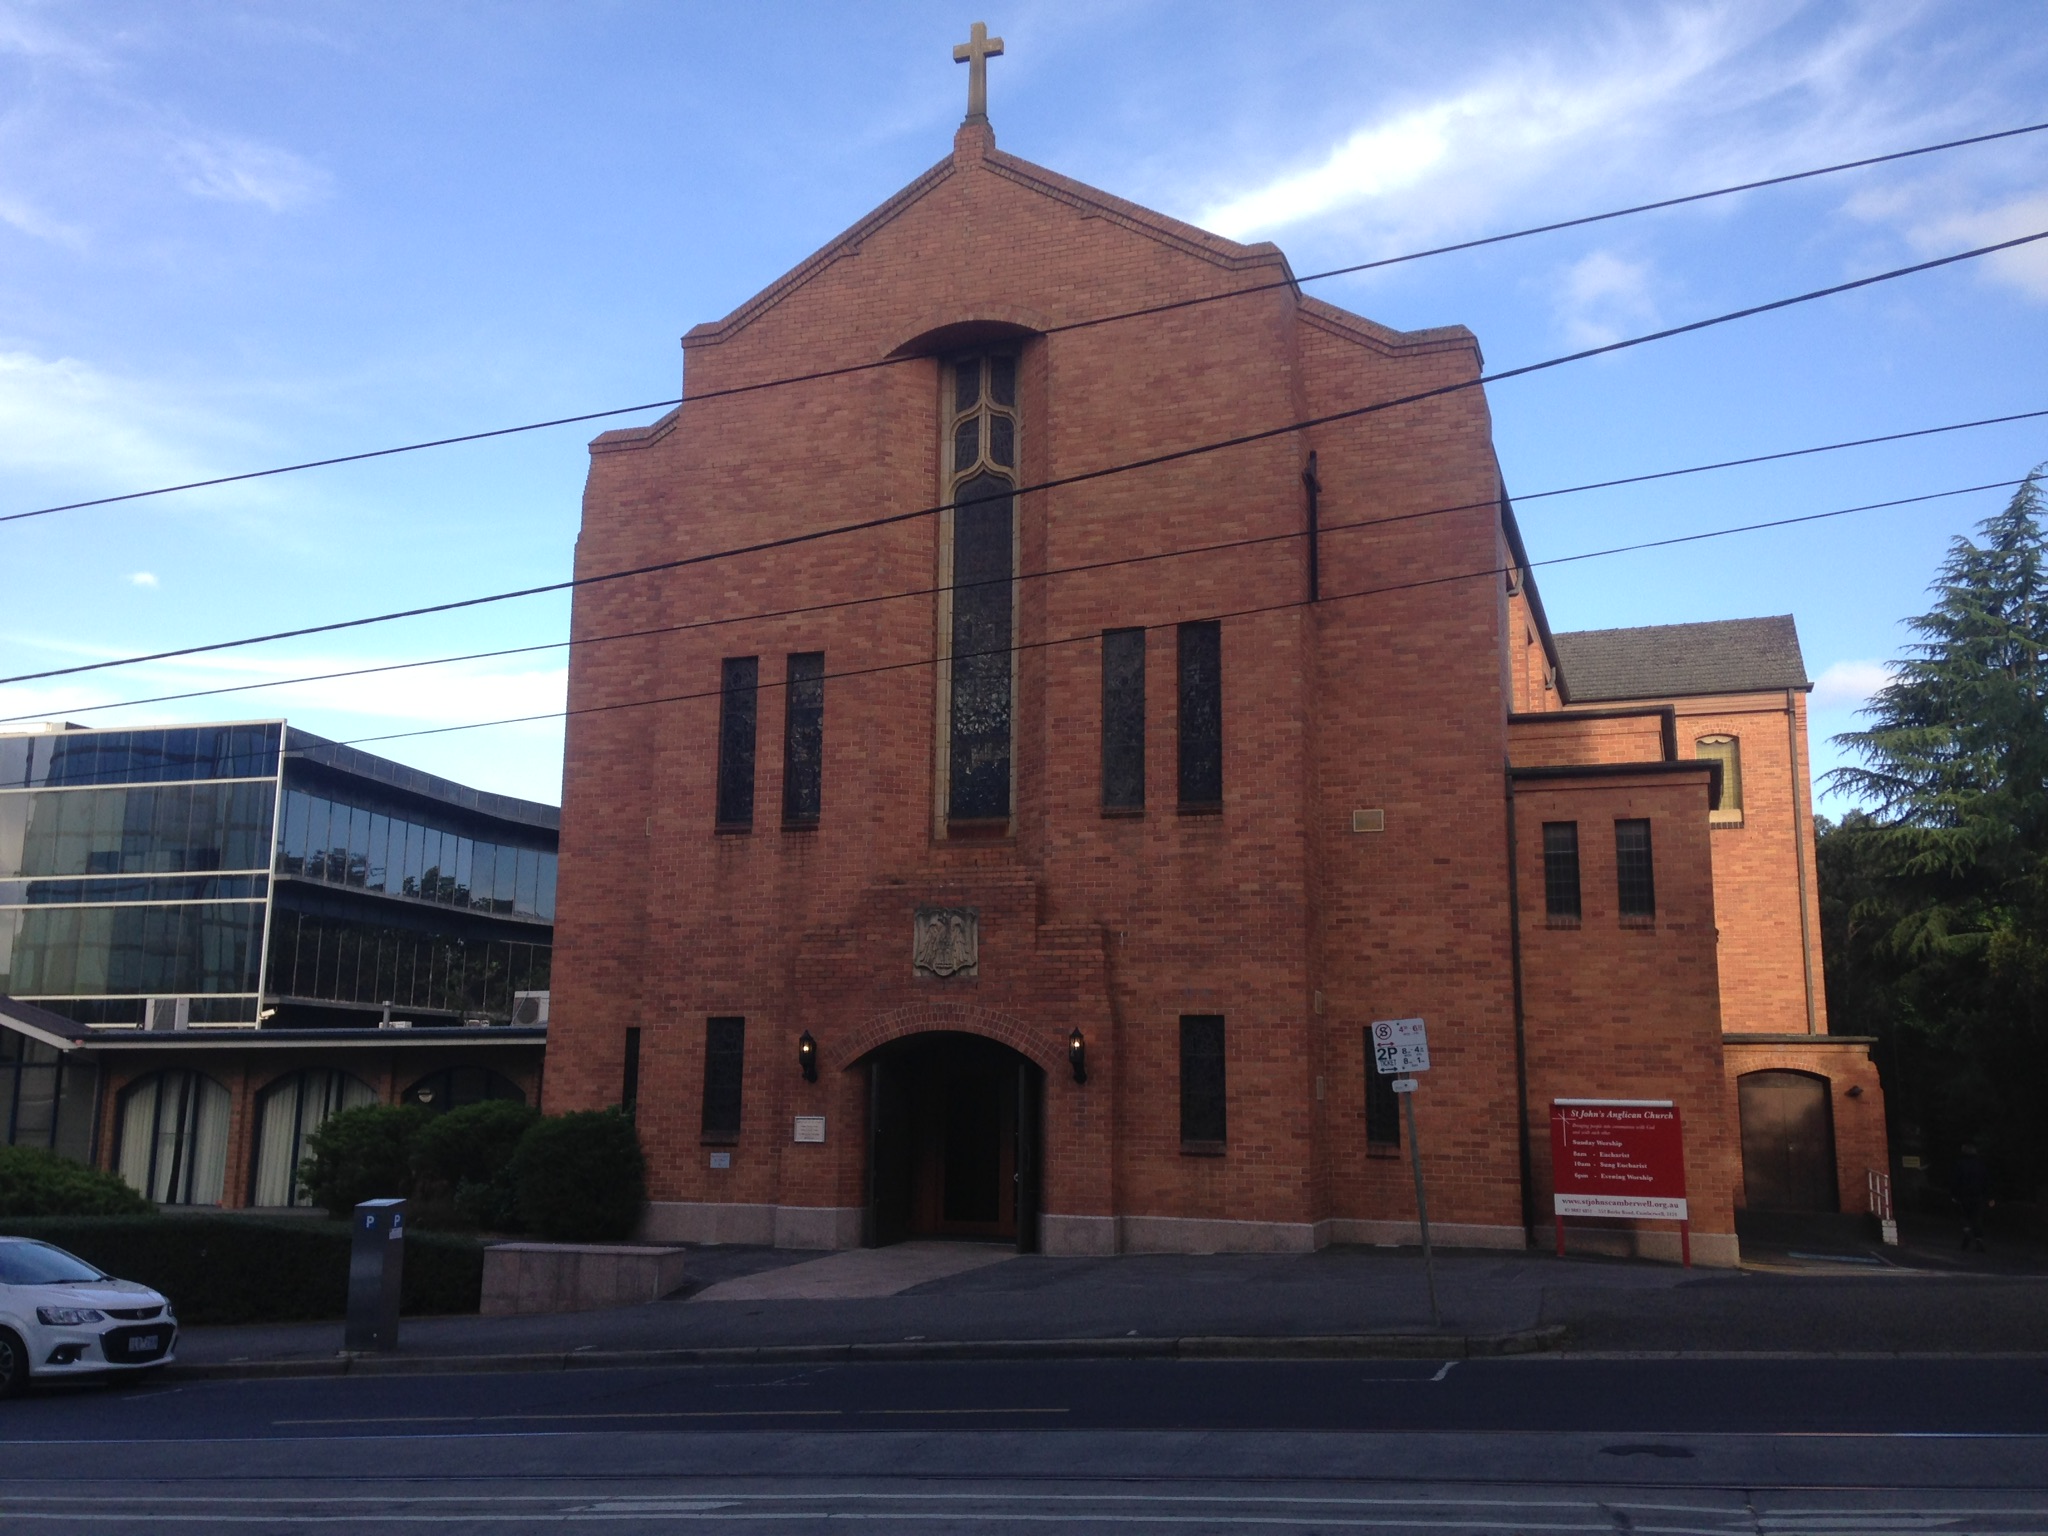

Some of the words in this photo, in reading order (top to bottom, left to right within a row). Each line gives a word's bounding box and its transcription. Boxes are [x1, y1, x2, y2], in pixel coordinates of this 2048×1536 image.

[1377, 1047, 1398, 1060] 2P
[1571, 1110, 1579, 1118] St
[1579, 1110, 1605, 1120] John's
[1607, 1111, 1642, 1121] Anglican
[1644, 1111, 1674, 1119] Church
[1572, 1139, 1595, 1147] Sunday
[1596, 1140, 1623, 1148] Worship
[1600, 1173, 1626, 1181] Evening
[1627, 1174, 1653, 1182] Worship
[1562, 1198, 1679, 1209] www.stjohnscamberwell.org.au
[366, 1215, 375, 1228] P
[394, 1214, 401, 1227] P
